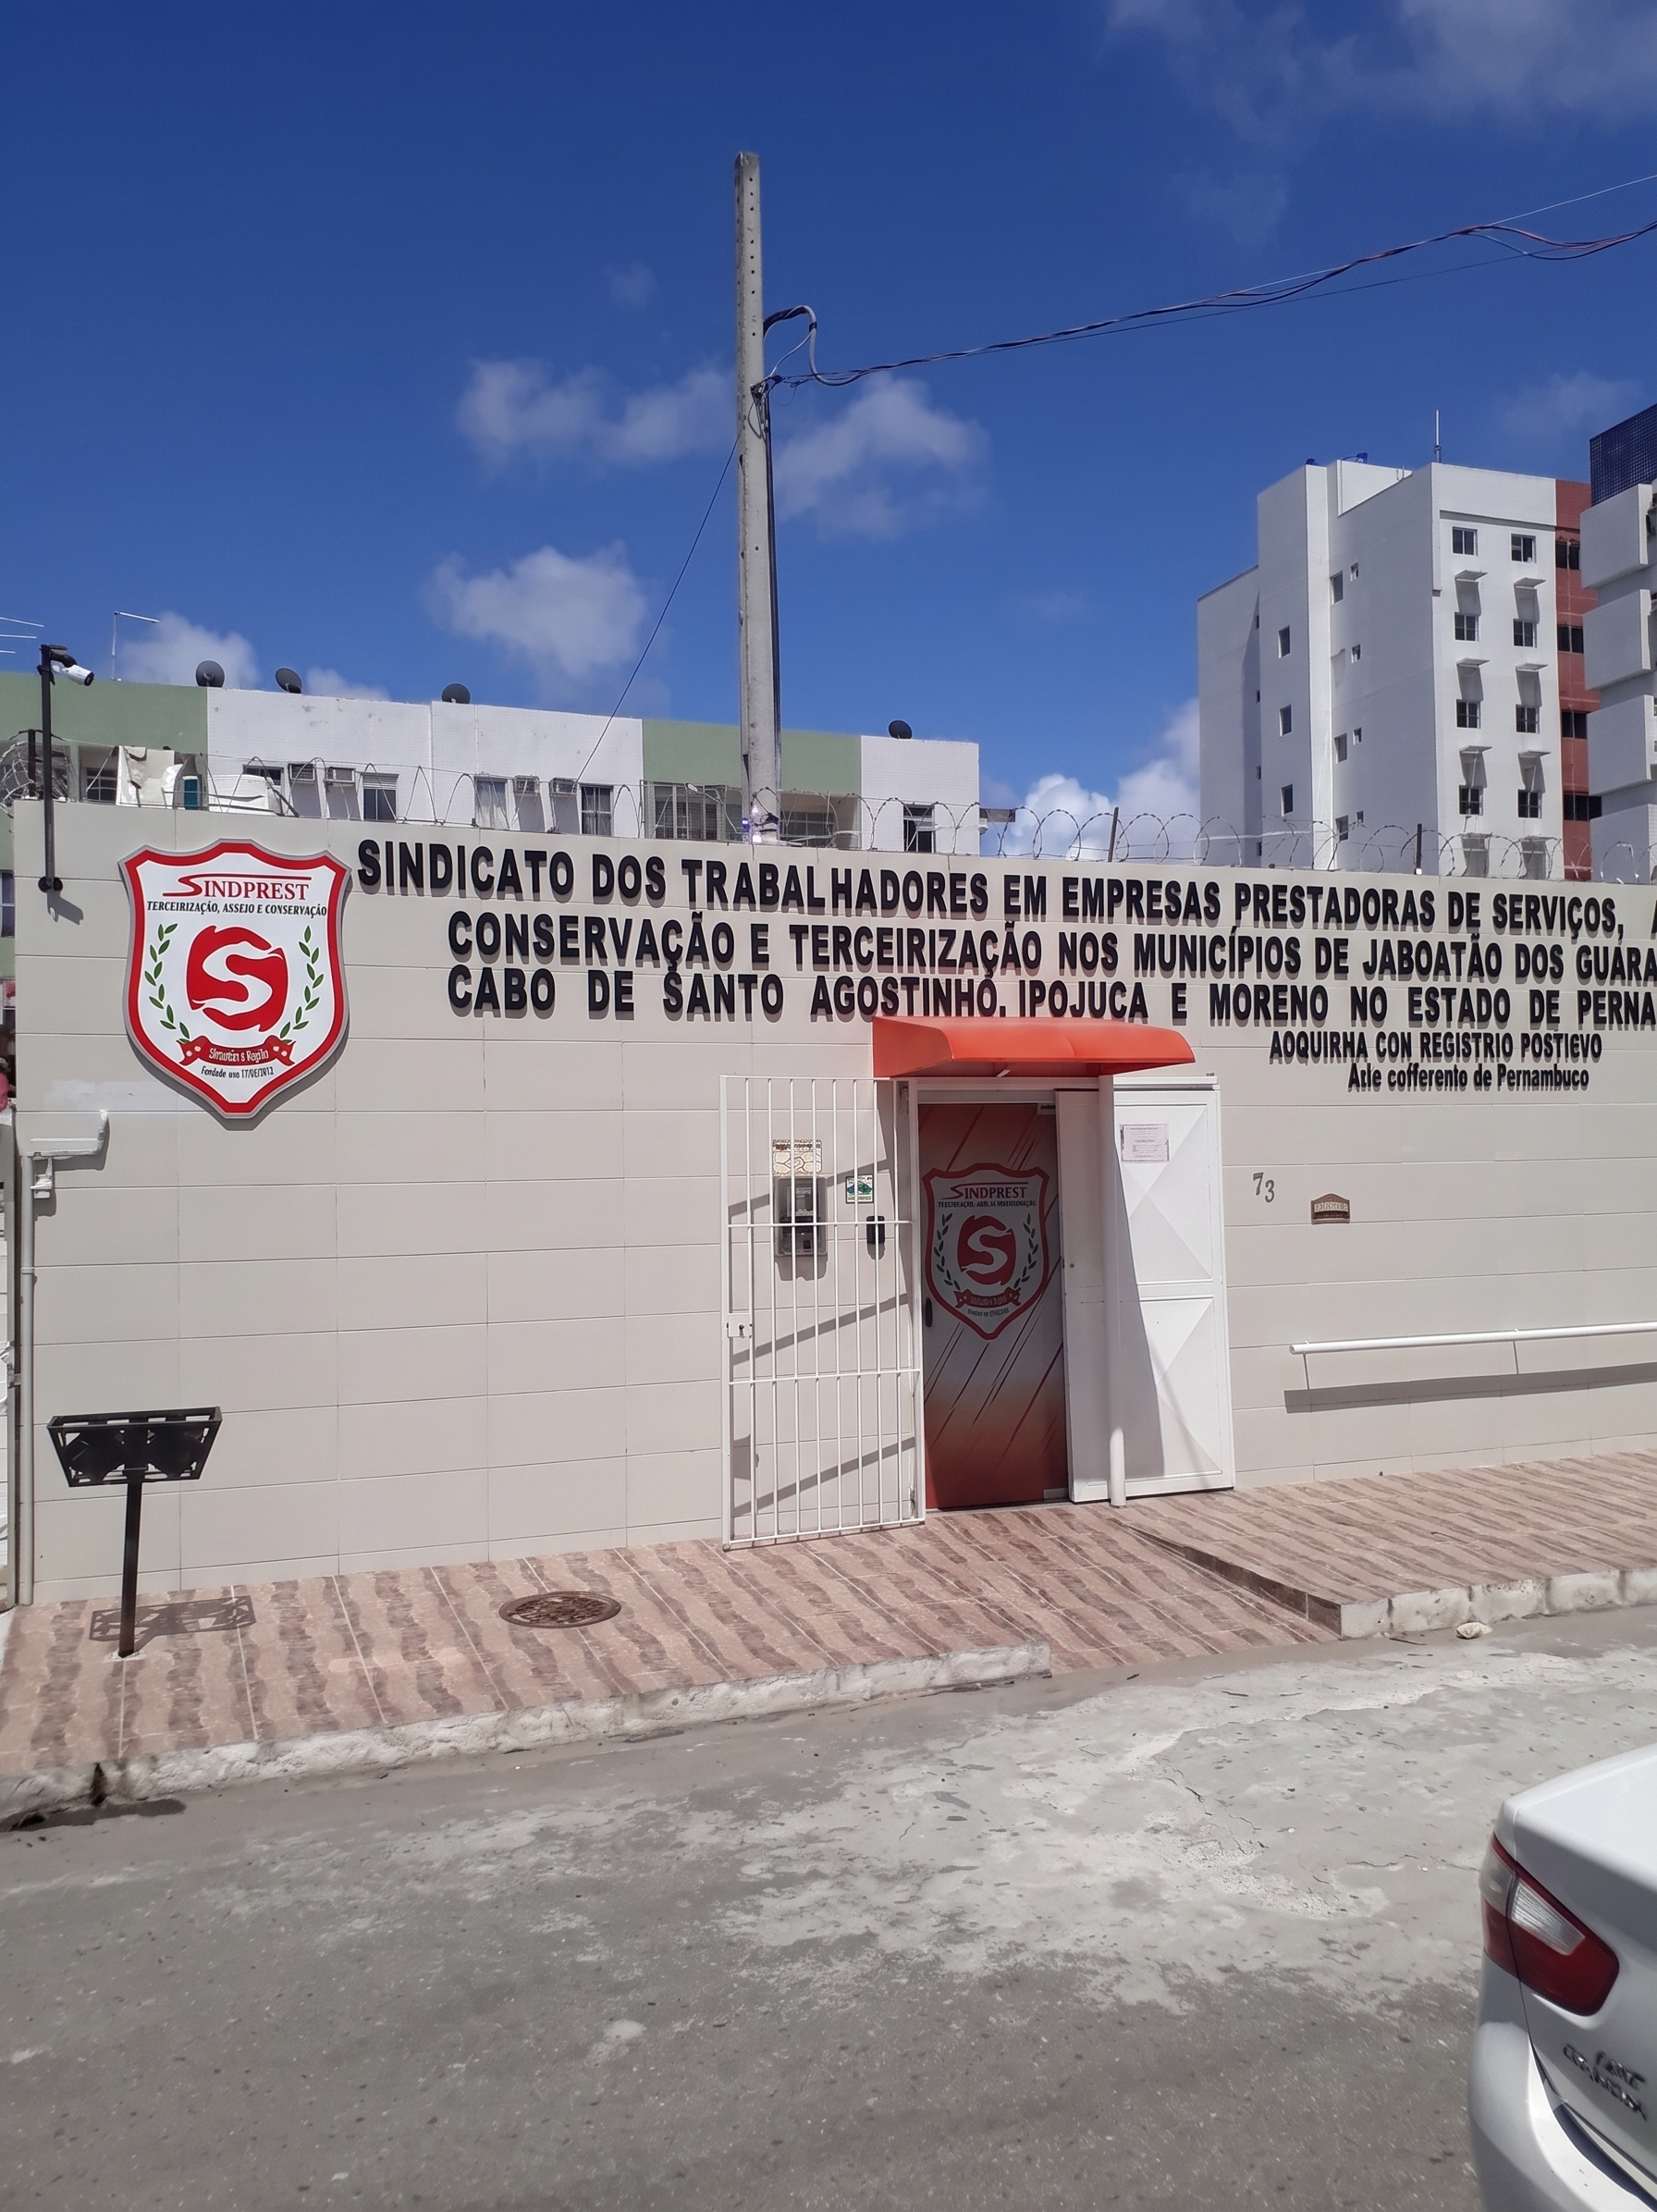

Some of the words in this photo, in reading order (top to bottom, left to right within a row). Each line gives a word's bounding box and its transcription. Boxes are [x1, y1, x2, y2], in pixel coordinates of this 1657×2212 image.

[163, 873, 313, 900] SINDPREST
[357, 839, 574, 896] SINDICATO
[592, 854, 666, 901] DOS
[681, 858, 988, 914] TRABALHADORES
[1003, 874, 1047, 916] EM
[1062, 877, 1221, 921] EMPRESAS
[1234, 882, 1435, 928] PRESTADORAS
[1448, 891, 1481, 928] DE
[1492, 892, 1624, 940] SERVIÇOS,
[257, 904, 263, 914] E
[448, 911, 735, 972] CONSERVAÇÃO
[750, 923, 769, 964] E
[789, 920, 1042, 978] TERCEIRIZAÇÃO
[1059, 931, 1119, 971] NOS
[1134, 926, 1301, 975] MUNICÍPIOS
[1315, 937, 1349, 975] DE
[1362, 933, 1503, 978] JABOATÃO
[1515, 943, 1565, 979] DOS
[1576, 944, 1657, 982] GUARA
[448, 964, 556, 1012] CABO
[587, 969, 634, 1013] DE
[663, 971, 784, 1015] SANTO
[1019, 979, 1149, 1019] IPOJUCA
[1171, 982, 1187, 1020] E
[1209, 983, 1329, 1022] MORENO
[1350, 986, 1388, 1023] NO
[1407, 986, 1511, 1024] ESTADO
[1528, 989, 1561, 1025] DE
[1577, 989, 1657, 1026] PERNA
[1270, 1030, 1369, 1059] AOQUIRHA
[1375, 1031, 1412, 1059] CON
[1419, 1031, 1514, 1059] REGISTRIO
[1473, 1063, 1492, 1088] de
[1497, 1063, 1589, 1088] Pernambuco
[940, 1182, 1029, 1200] SINDPREST
[1253, 1172, 1275, 1203] 73
